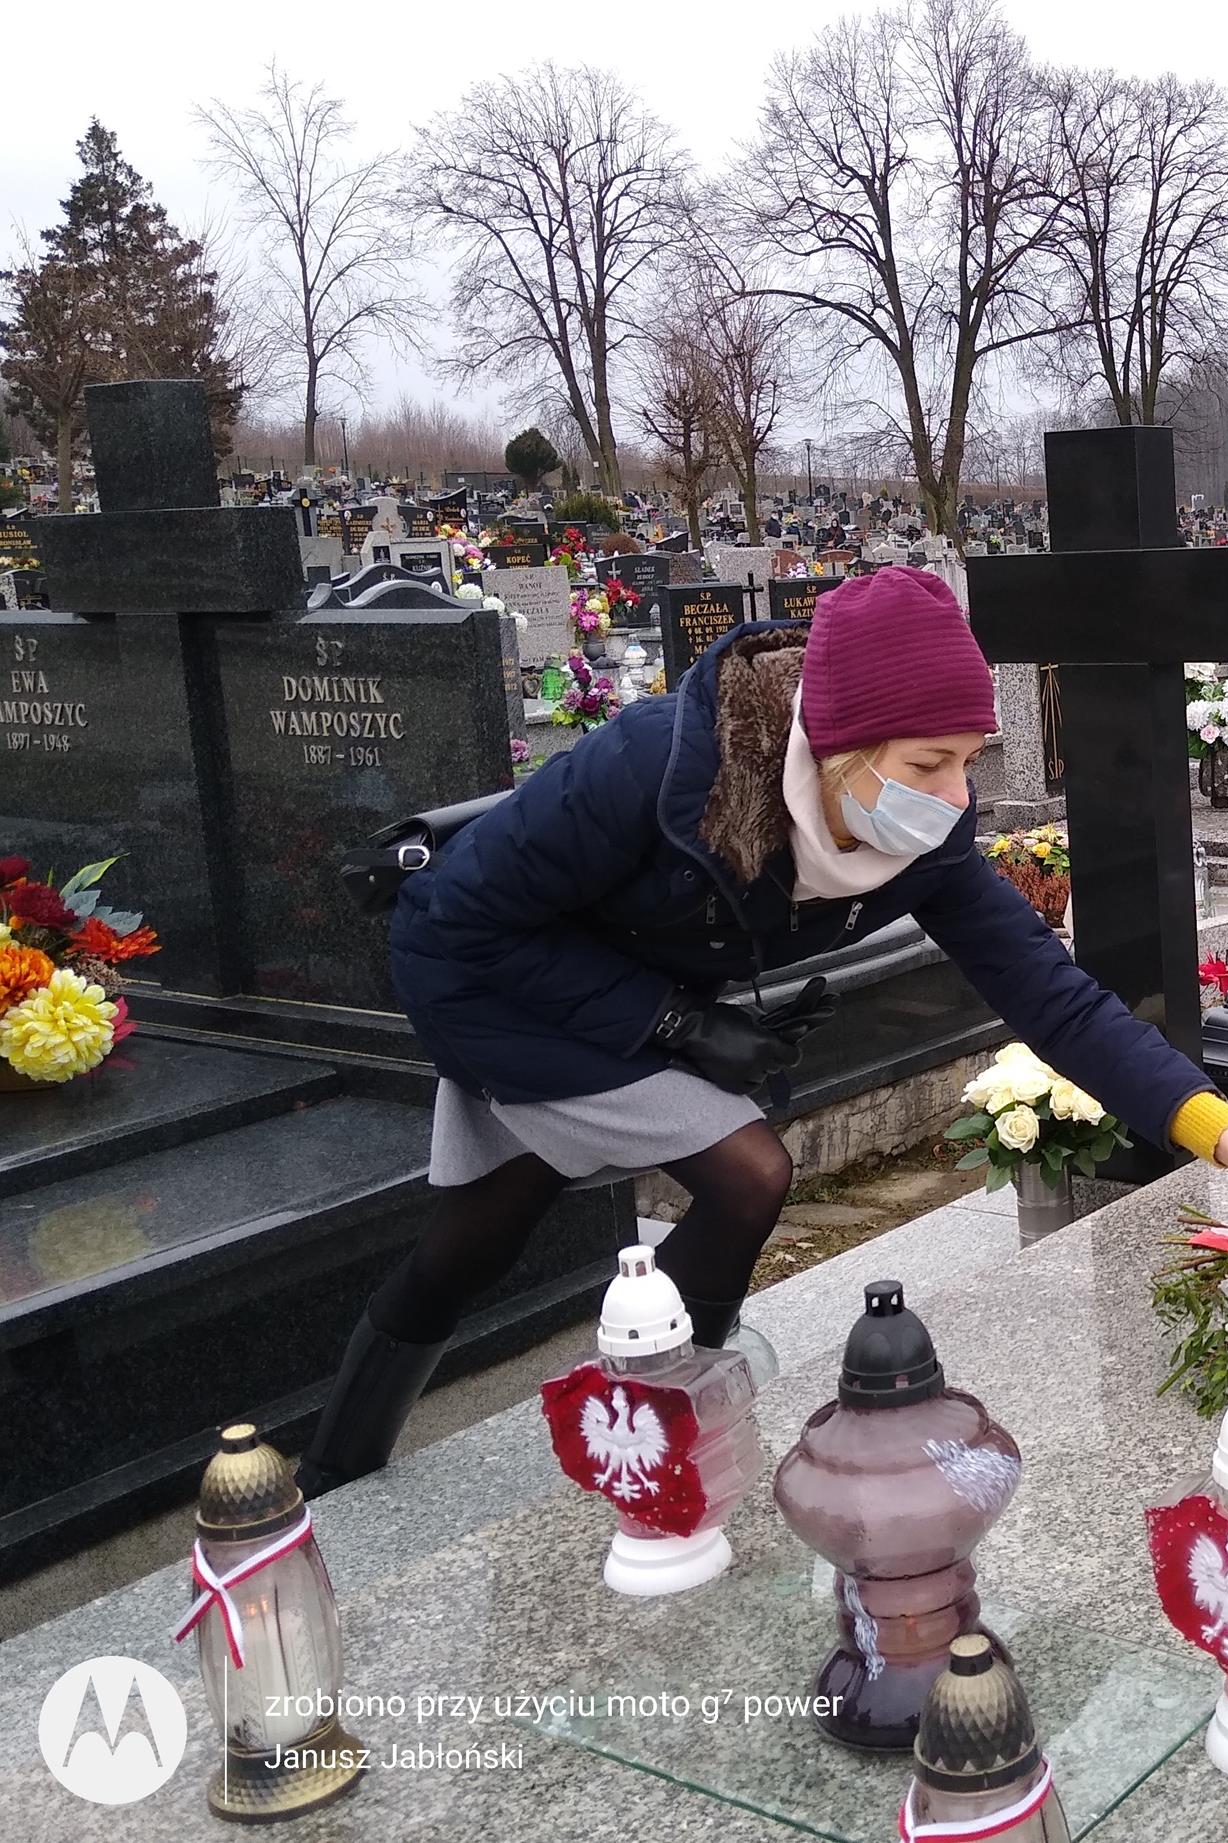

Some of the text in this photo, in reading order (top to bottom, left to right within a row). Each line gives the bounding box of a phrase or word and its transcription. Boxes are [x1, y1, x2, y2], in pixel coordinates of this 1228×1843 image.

[679, 614, 735, 627] FRANCISZEK
[684, 604, 728, 616] BECZAŁA
[11, 670, 50, 693] EWA
[282, 676, 384, 704] DOMINIK
[0, 700, 88, 727] AMPOSZYC
[270, 710, 406, 739] WAMPOSZYC
